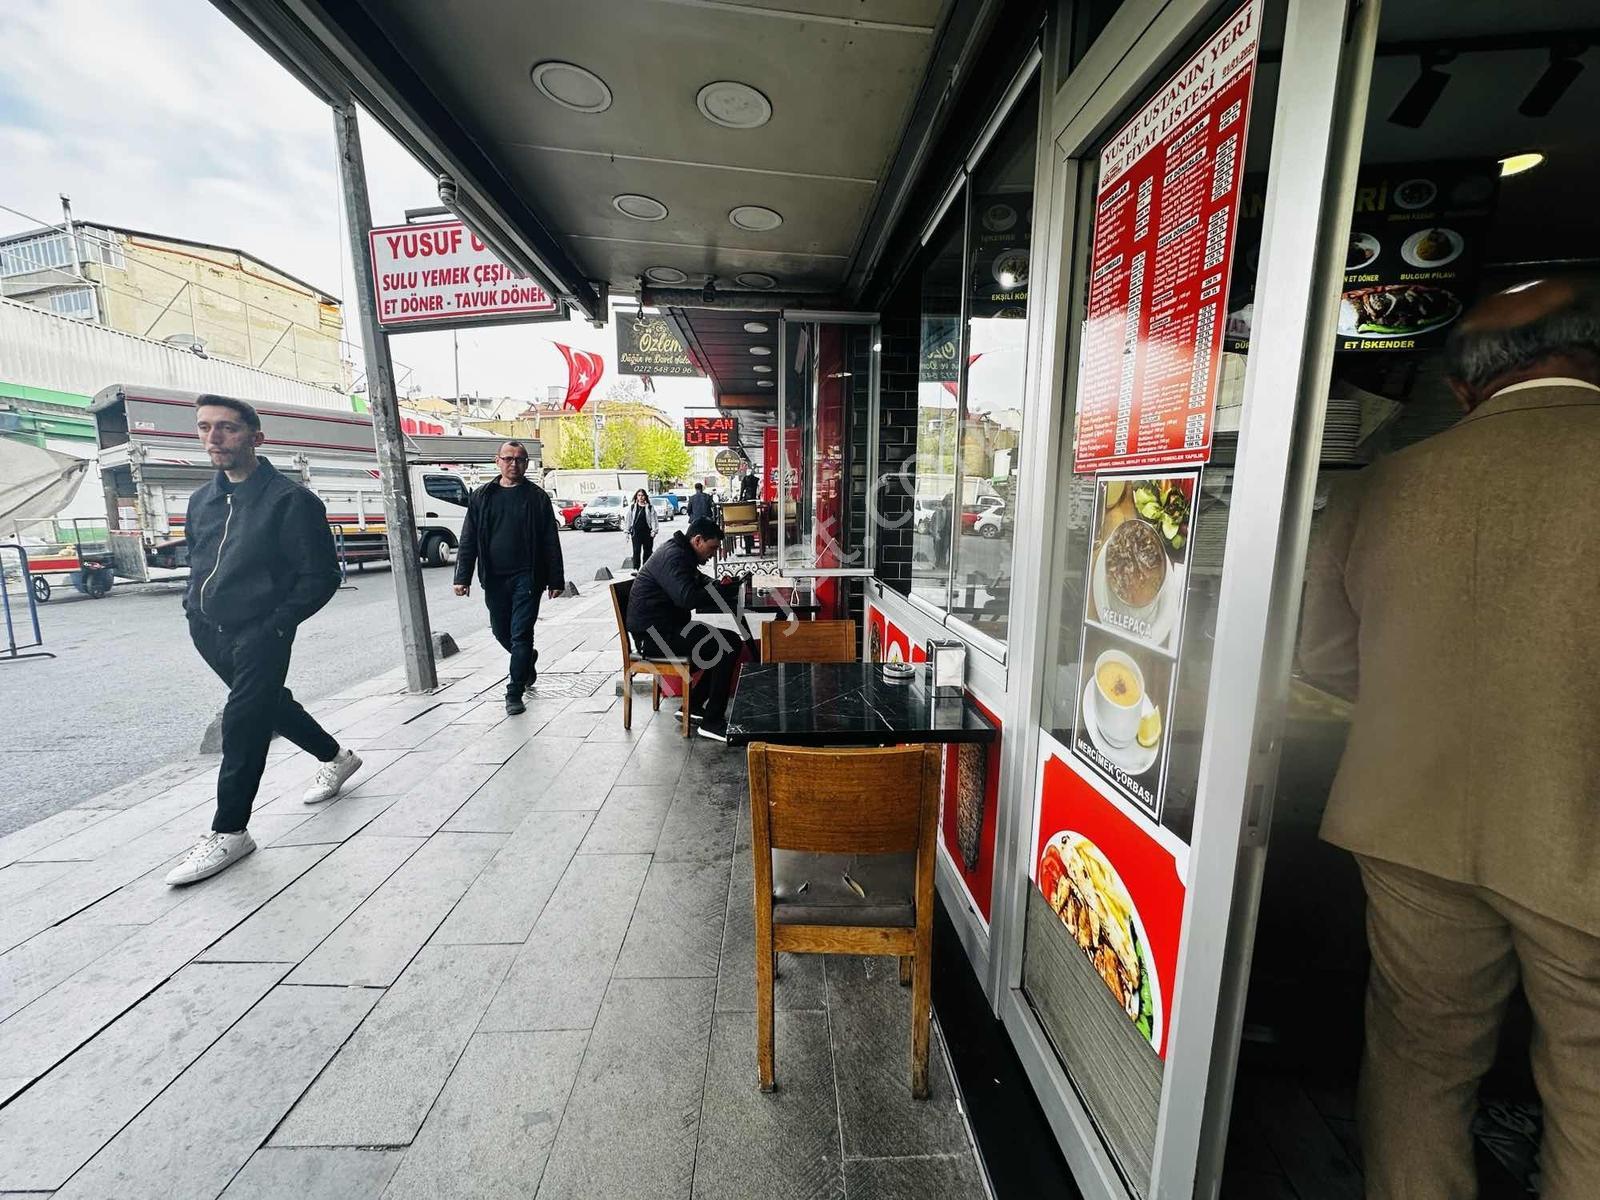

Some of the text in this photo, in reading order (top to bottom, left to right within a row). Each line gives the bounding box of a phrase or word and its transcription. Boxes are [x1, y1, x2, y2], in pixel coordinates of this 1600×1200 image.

[1104, 5, 1254, 166] YUSUF USTANIN YERİ
[1125, 121, 1158, 166] FİYAT
[1160, 67, 1216, 133] LİSTESİ
[1169, 118, 1205, 153] PİLAVLAR
[1165, 148, 1204, 184] ET DÖNERLER
[1101, 182, 1127, 211] ÇORBALAR
[387, 230, 462, 259] YUSUF
[383, 272, 418, 291] SULU
[422, 267, 470, 287] YEMEK
[1358, 273, 1379, 282] DÖNER
[1431, 271, 1456, 280] PİLAVI
[384, 299, 397, 314] ET
[401, 293, 443, 313] DÖNER
[455, 291, 497, 309] TAVUK
[501, 284, 546, 305] DÖNER
[639, 328, 683, 352] Özlem
[1344, 339, 1415, 349] ET İSKENDER
[633, 365, 651, 373] 0212
[669, 366, 680, 374] 20
[1103, 608, 1153, 640] KELLEPAÇA
[1077, 738, 1154, 806] MERCİMEK ÇORBASI
